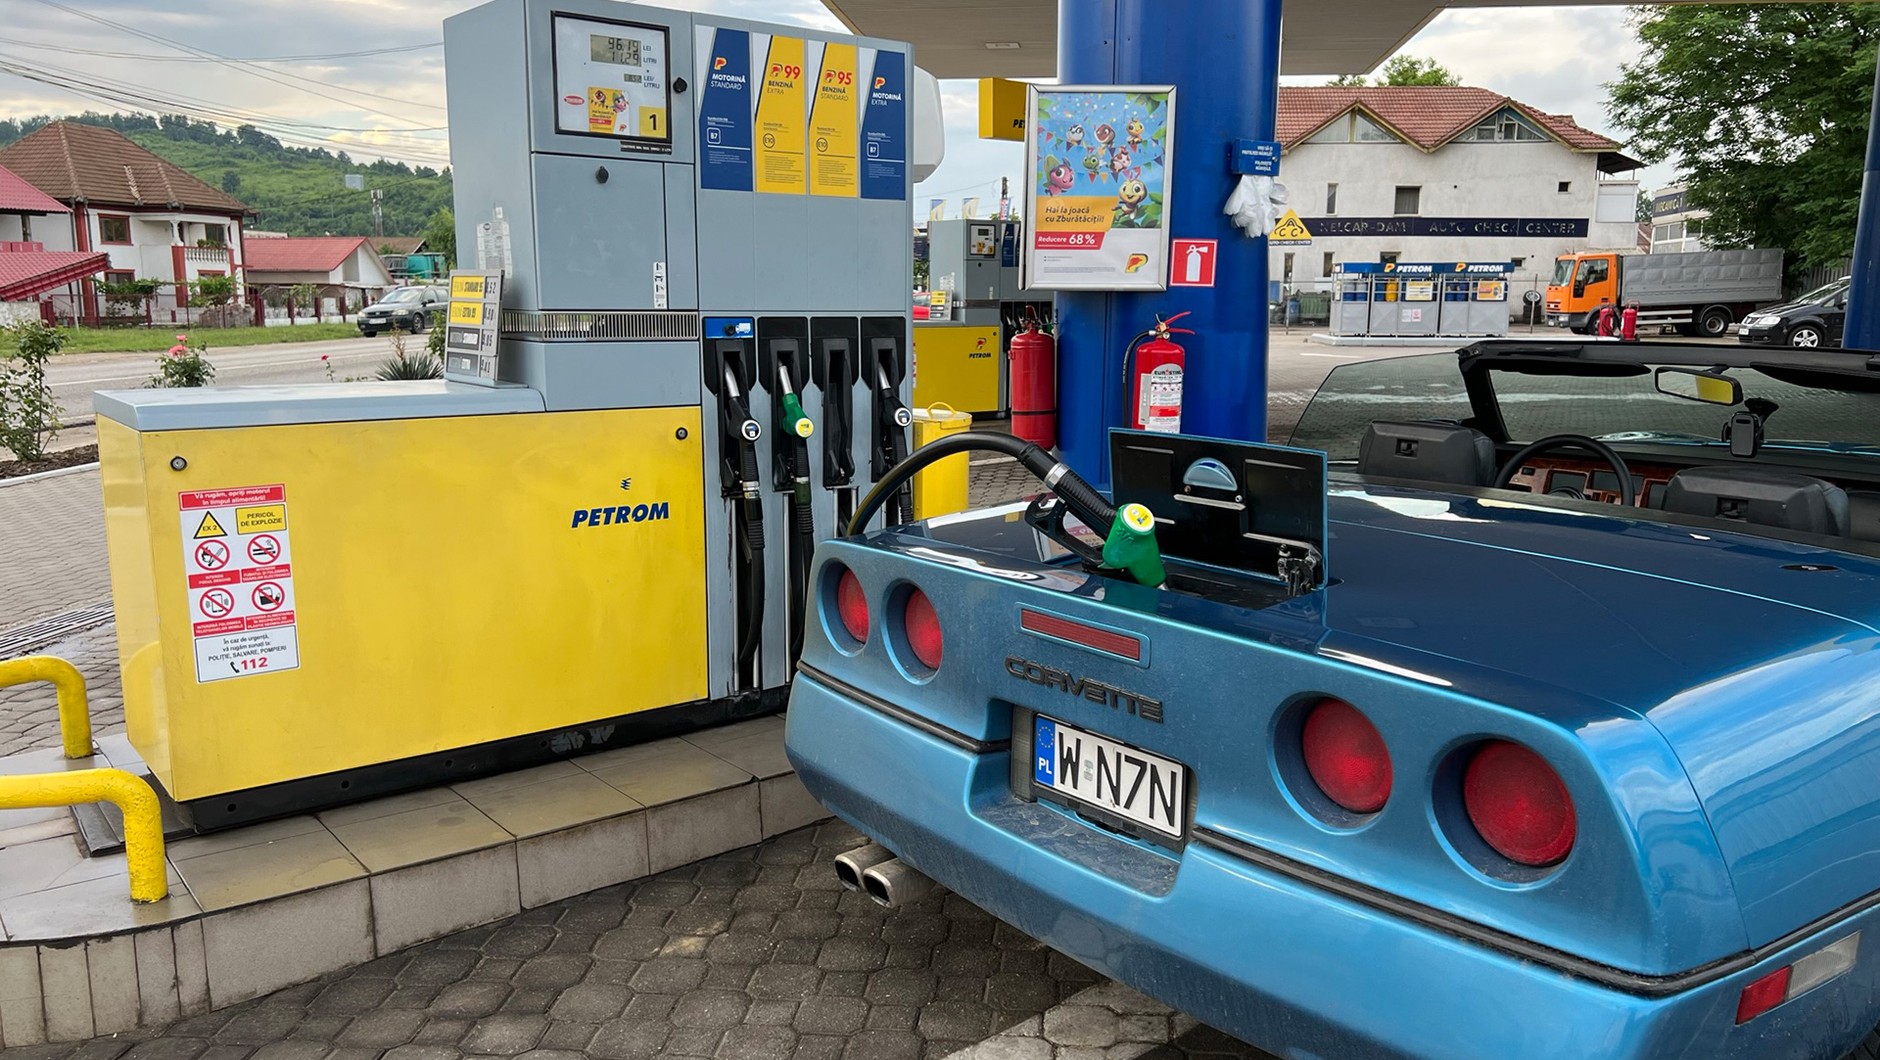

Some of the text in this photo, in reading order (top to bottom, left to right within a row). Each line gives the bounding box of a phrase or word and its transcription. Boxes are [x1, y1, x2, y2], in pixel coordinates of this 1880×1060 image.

[608, 37, 639, 53] 96.19
[783, 65, 801, 80] 99
[837, 71, 853, 86] 95
[710, 80, 742, 91] STANDARD
[766, 87, 785, 95] EXTRA
[820, 93, 849, 102] STANDARD
[649, 113, 657, 131] 1
[1046, 206, 1060, 214] Hai
[1060, 205, 1067, 214] la
[1396, 264, 1433, 273] PETROM
[1467, 264, 1504, 273] PETROM
[247, 511, 276, 520] PERICOL
[571, 501, 669, 528] PETROM
[240, 517, 283, 528] DE EXPLOZIE
[260, 645, 287, 655] POMPIERI
[241, 657, 269, 671] 112
[1004, 655, 1164, 724] CORVETTE
[1038, 731, 1177, 828] PL W N7N
